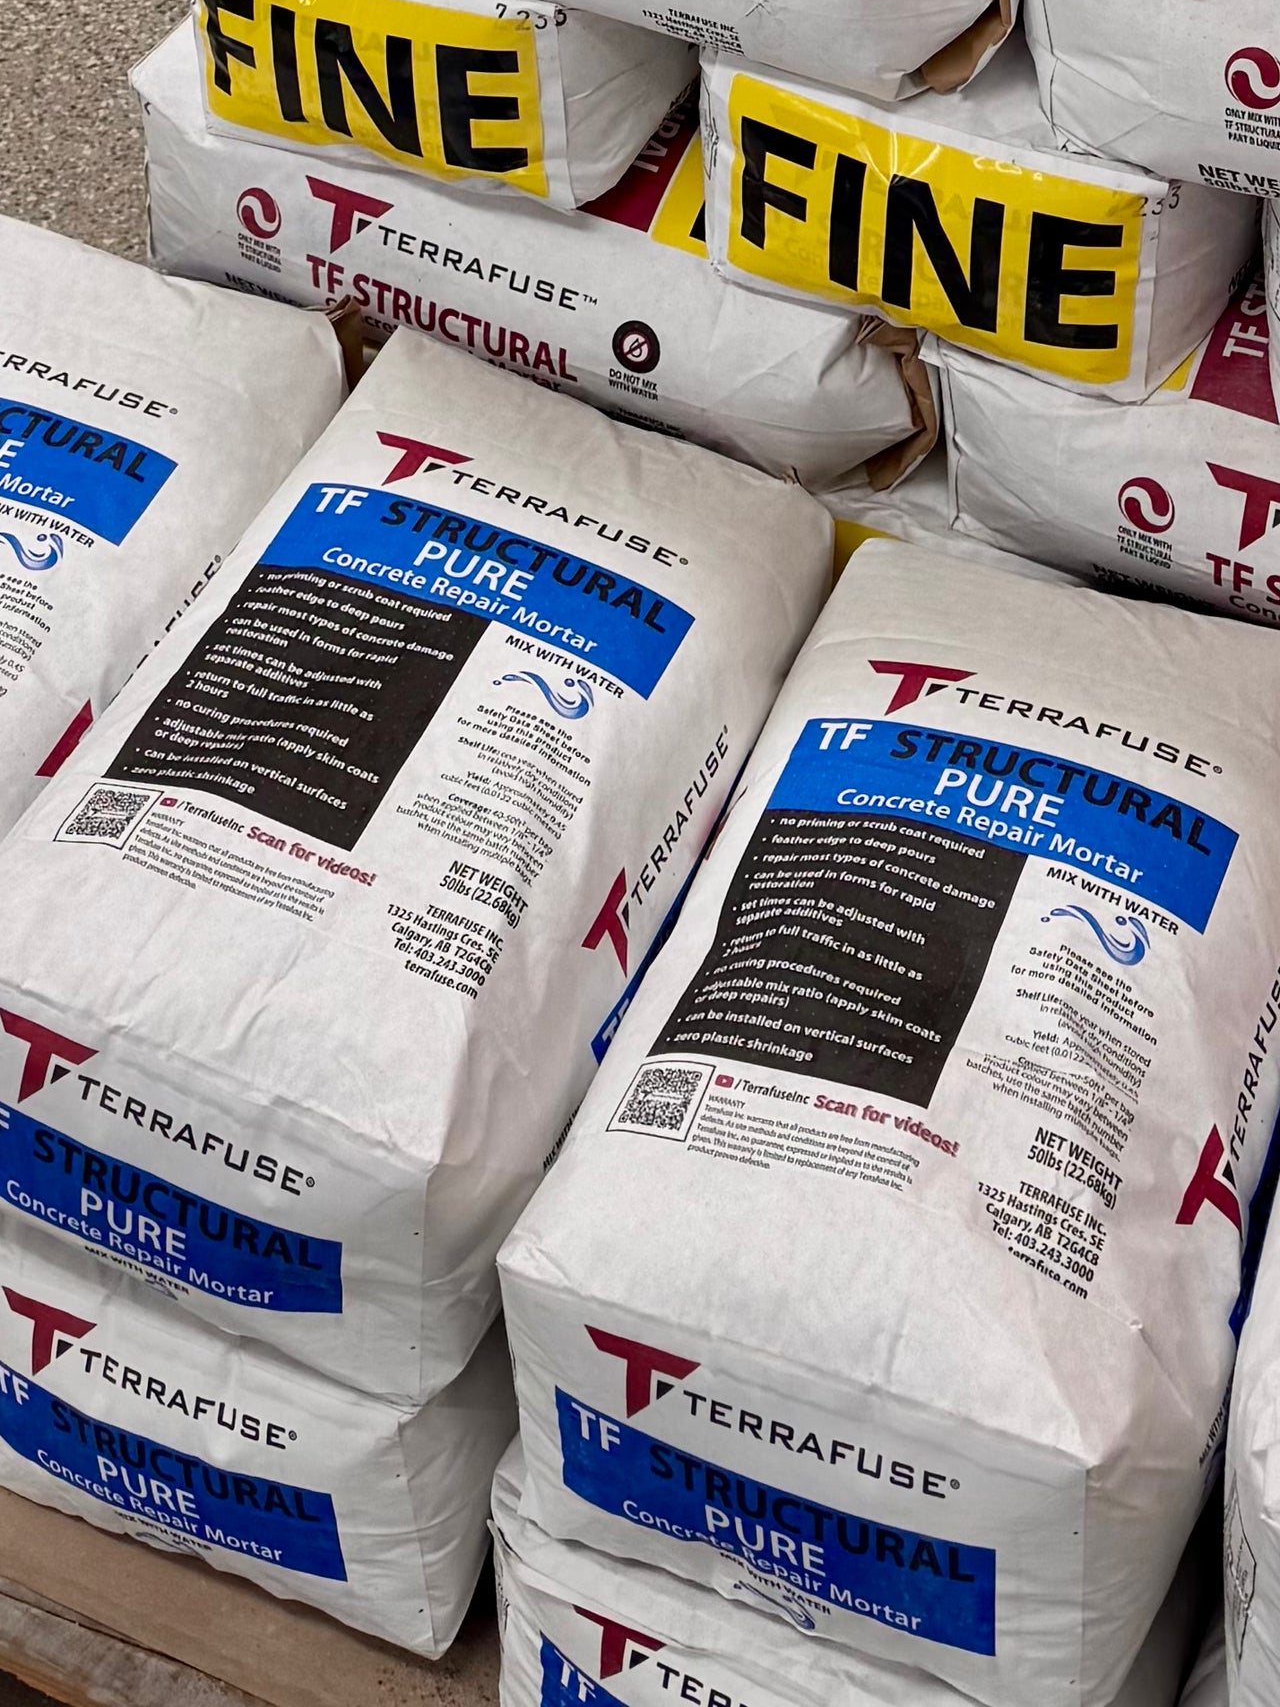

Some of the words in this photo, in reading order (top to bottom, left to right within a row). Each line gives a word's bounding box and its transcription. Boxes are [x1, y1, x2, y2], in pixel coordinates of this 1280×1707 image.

[737, 114, 1121, 355] FINE
[450, 467, 679, 569] TERRAFUSE
[421, 539, 529, 602] PURE
[954, 683, 1212, 779] TERRAFUSE
[817, 720, 874, 753] TF
[890, 726, 1214, 857] STRUCTURAL
[934, 765, 1067, 829] PURE
